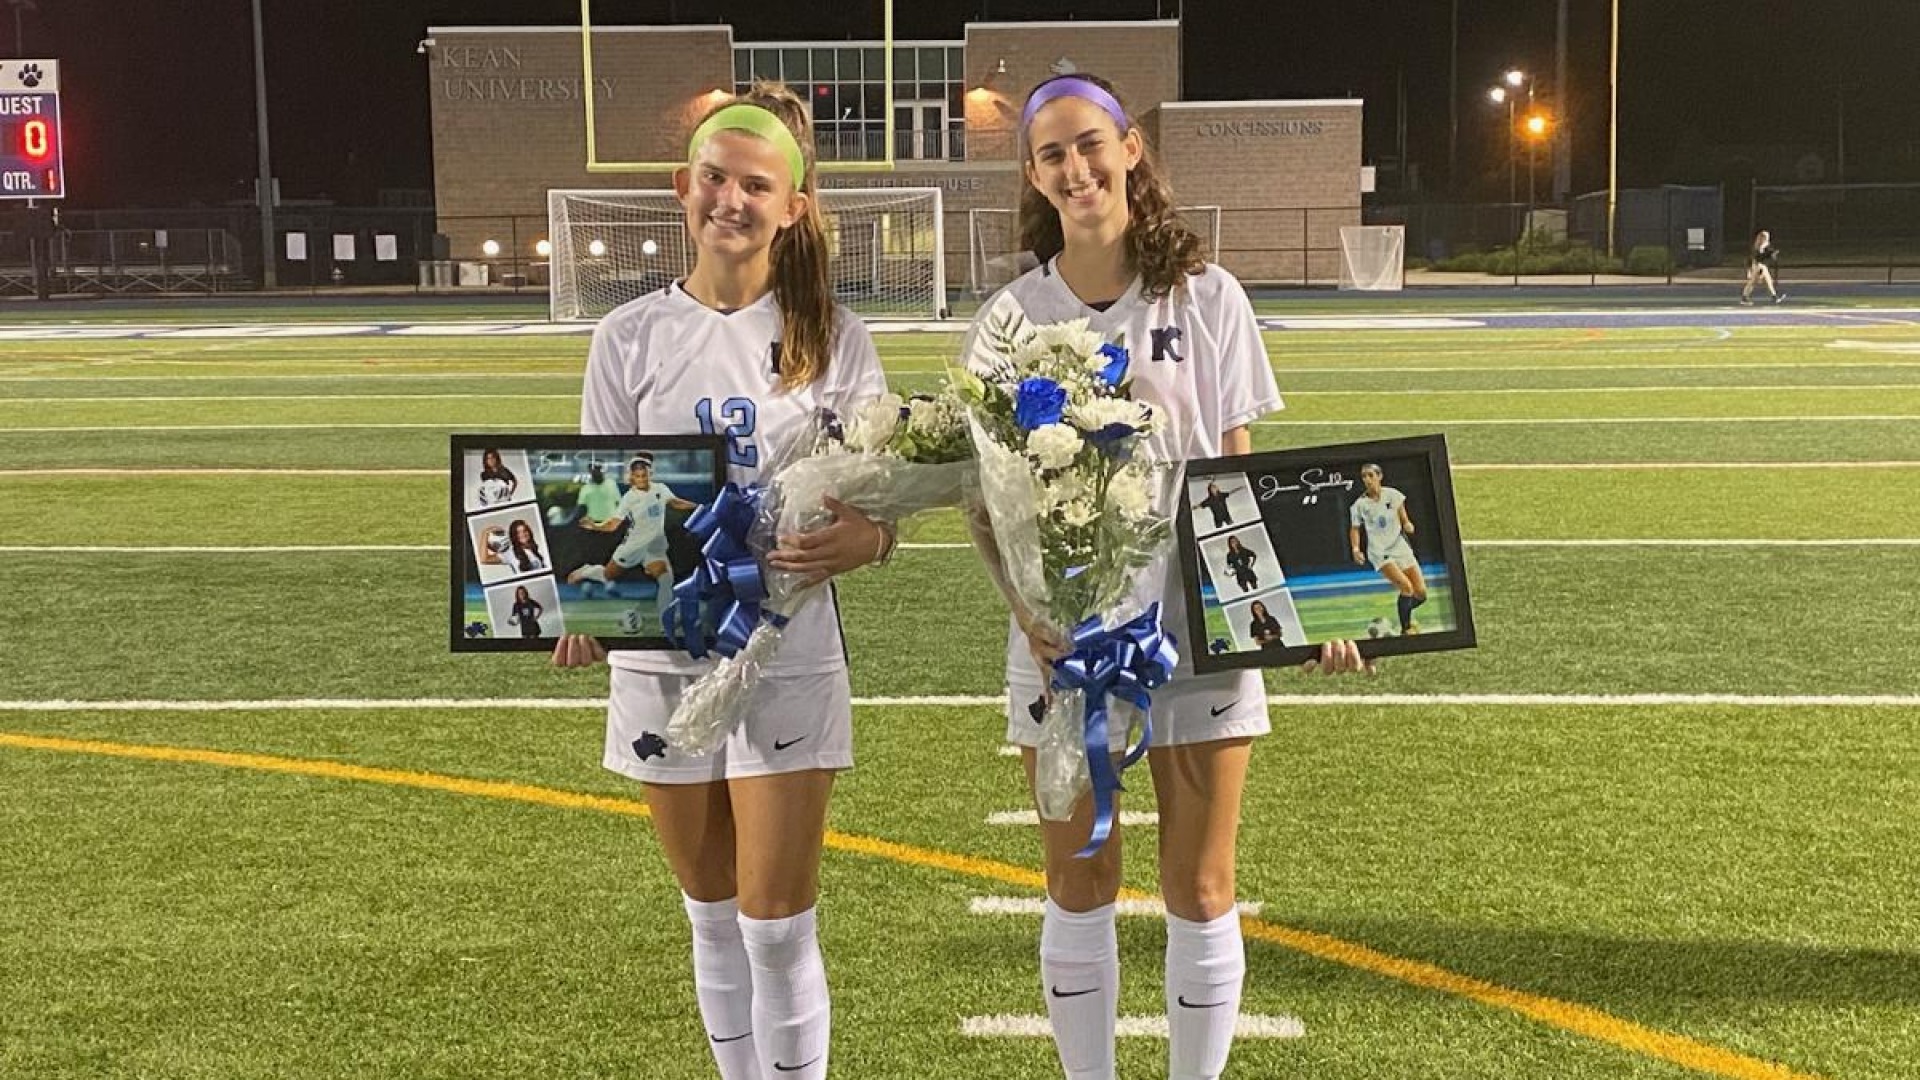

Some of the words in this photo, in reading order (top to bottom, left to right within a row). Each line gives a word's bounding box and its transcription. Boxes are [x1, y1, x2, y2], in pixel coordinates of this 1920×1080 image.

[443, 47, 521, 69] KEAN
[444, 79, 617, 100] UNIVERSIY
[25, 120, 47, 156] 0
[1197, 120, 1322, 136] CONCESSIONS
[3, 171, 36, 191] QTR.
[924, 177, 984, 190] HOUSE
[695, 397, 758, 467] 12
